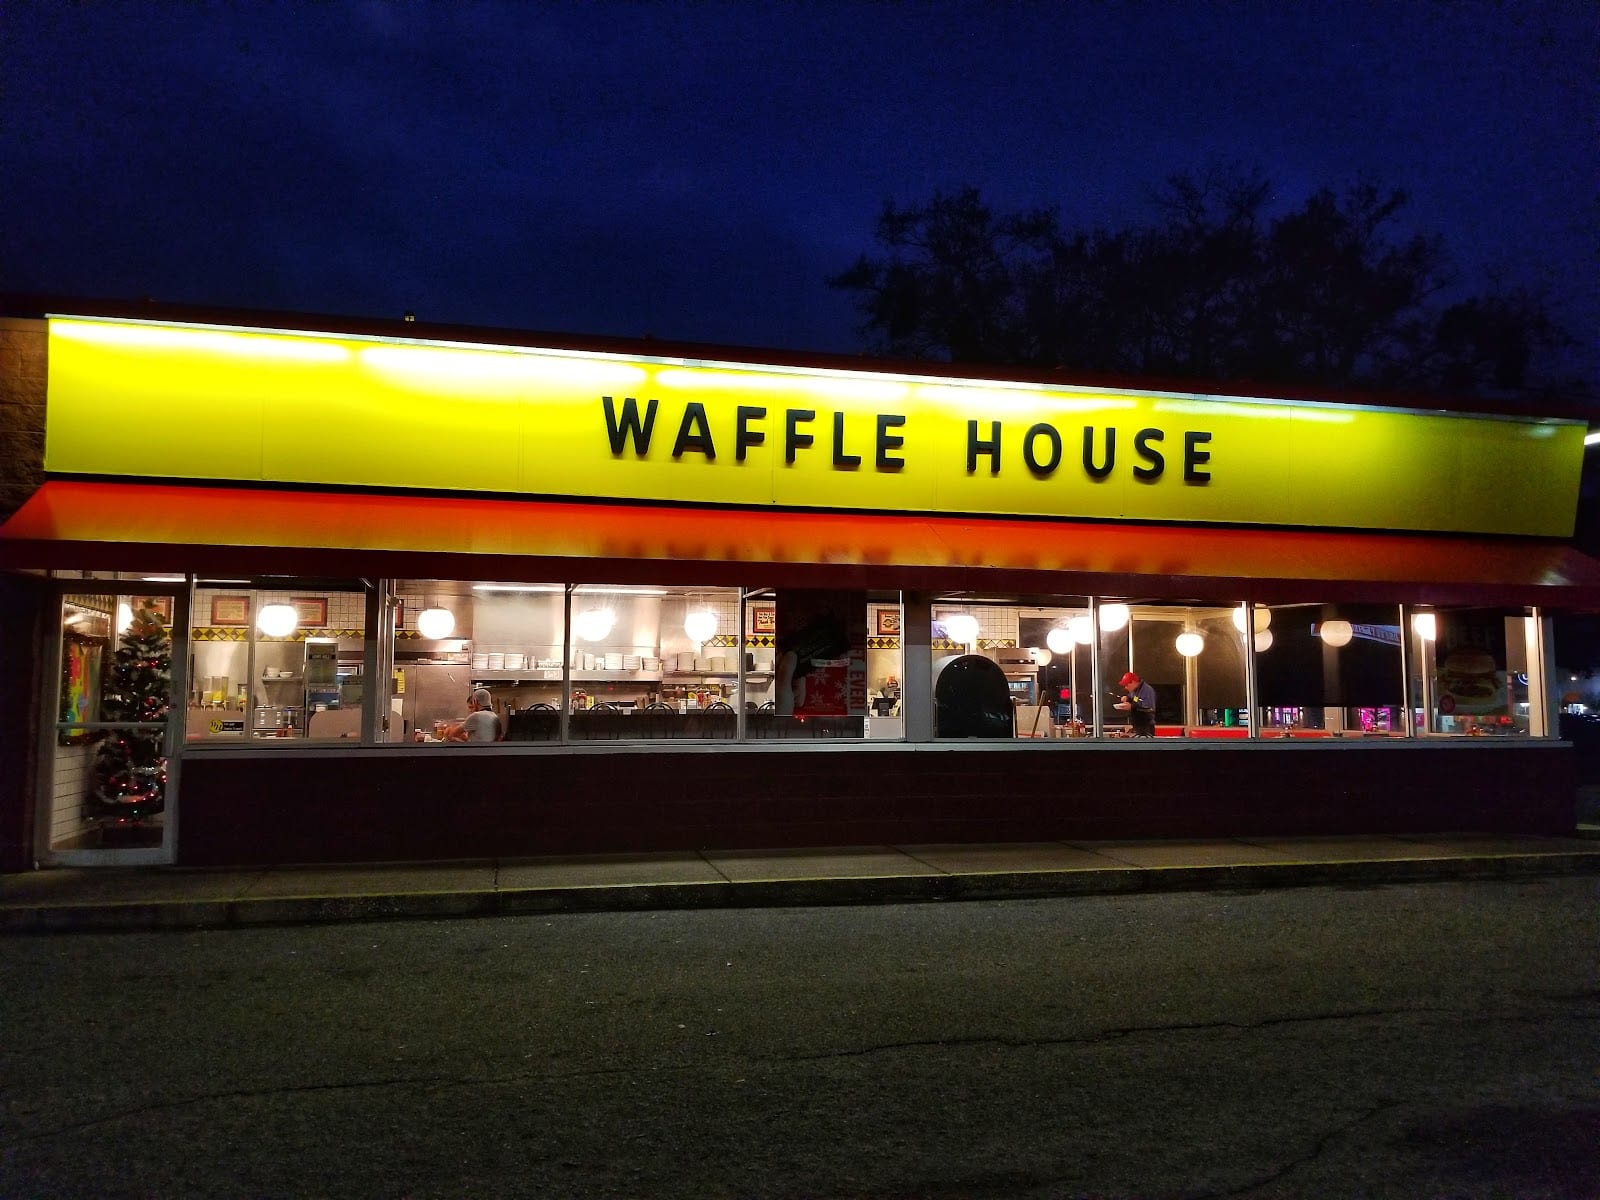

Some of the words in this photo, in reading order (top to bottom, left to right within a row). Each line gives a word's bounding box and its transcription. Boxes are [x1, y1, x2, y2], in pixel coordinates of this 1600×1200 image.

[602, 397, 906, 471] WAFFLE
[967, 419, 1212, 483] HOUSE
[849, 671, 866, 711] EVER!
